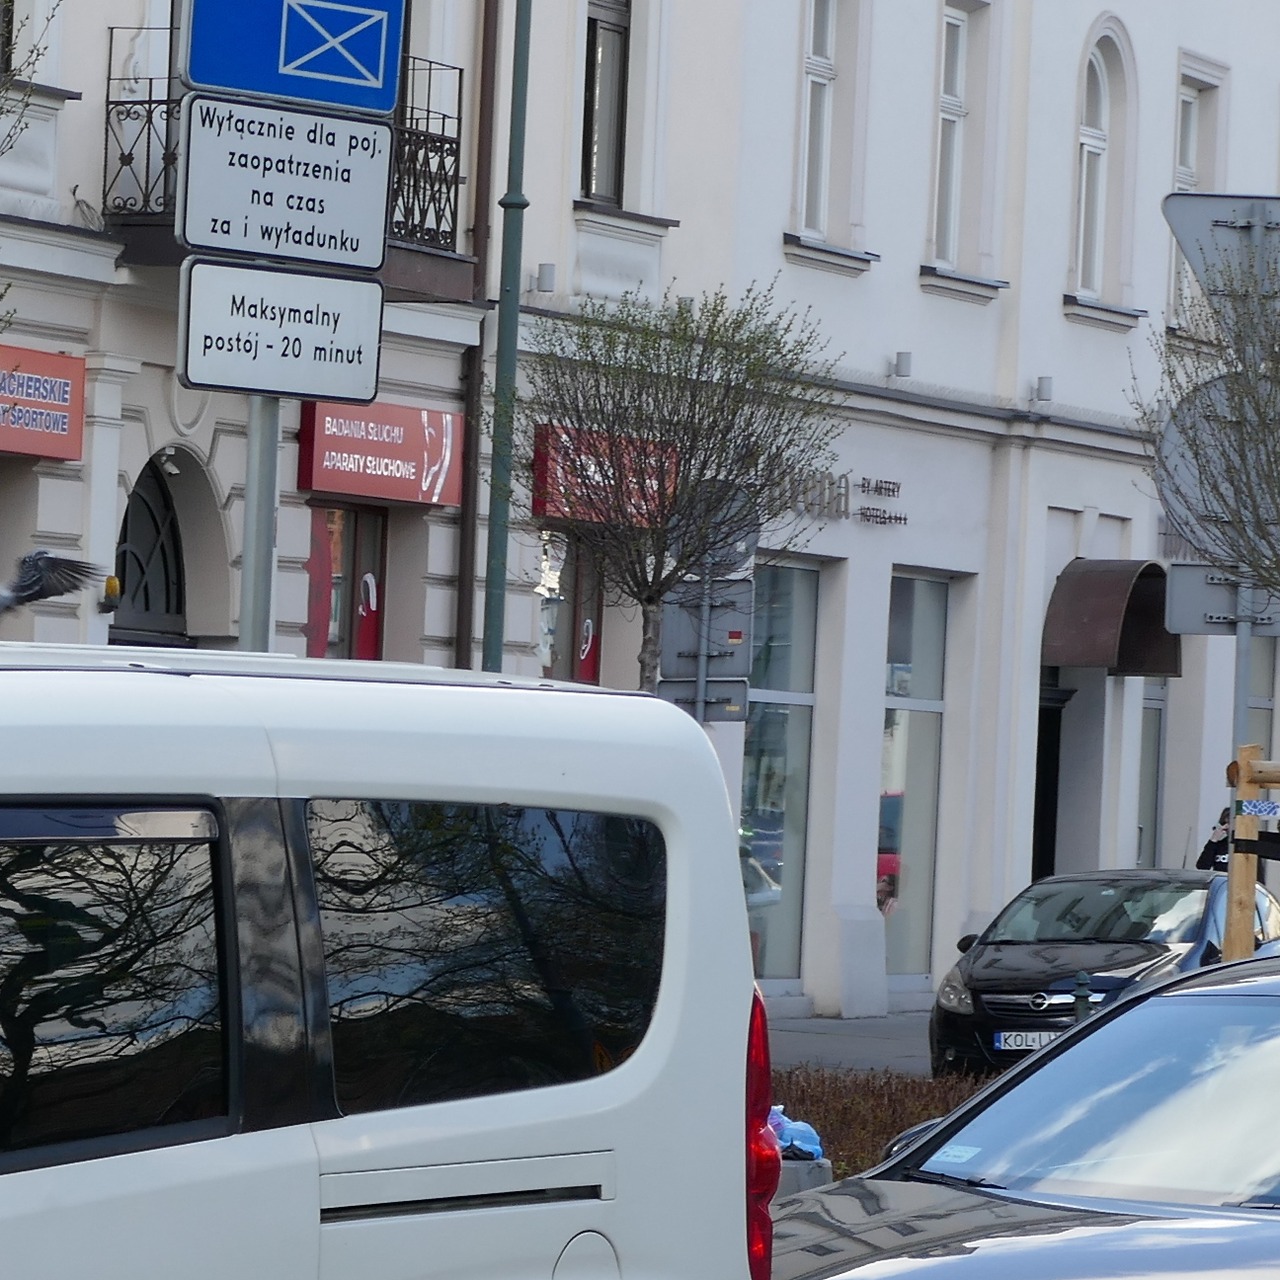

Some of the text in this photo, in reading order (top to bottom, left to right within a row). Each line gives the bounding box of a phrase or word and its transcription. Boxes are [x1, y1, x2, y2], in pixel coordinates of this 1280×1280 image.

[199, 105, 383, 160] Wyłącznie dla poj.
[228, 151, 352, 183] zaopatrzenia
[251, 189, 325, 214] na czas
[210, 215, 360, 252] za i wyładunku
[230, 294, 340, 334] Maksymalny
[203, 331, 259, 361] postój
[280, 336, 302, 359] 20
[313, 340, 363, 365] minut
[9, 407, 69, 435] SPORTOWE
[325, 416, 404, 444] BADANIA SŁUCHU
[323, 451, 417, 480] APARATY SŁUCHOWE
